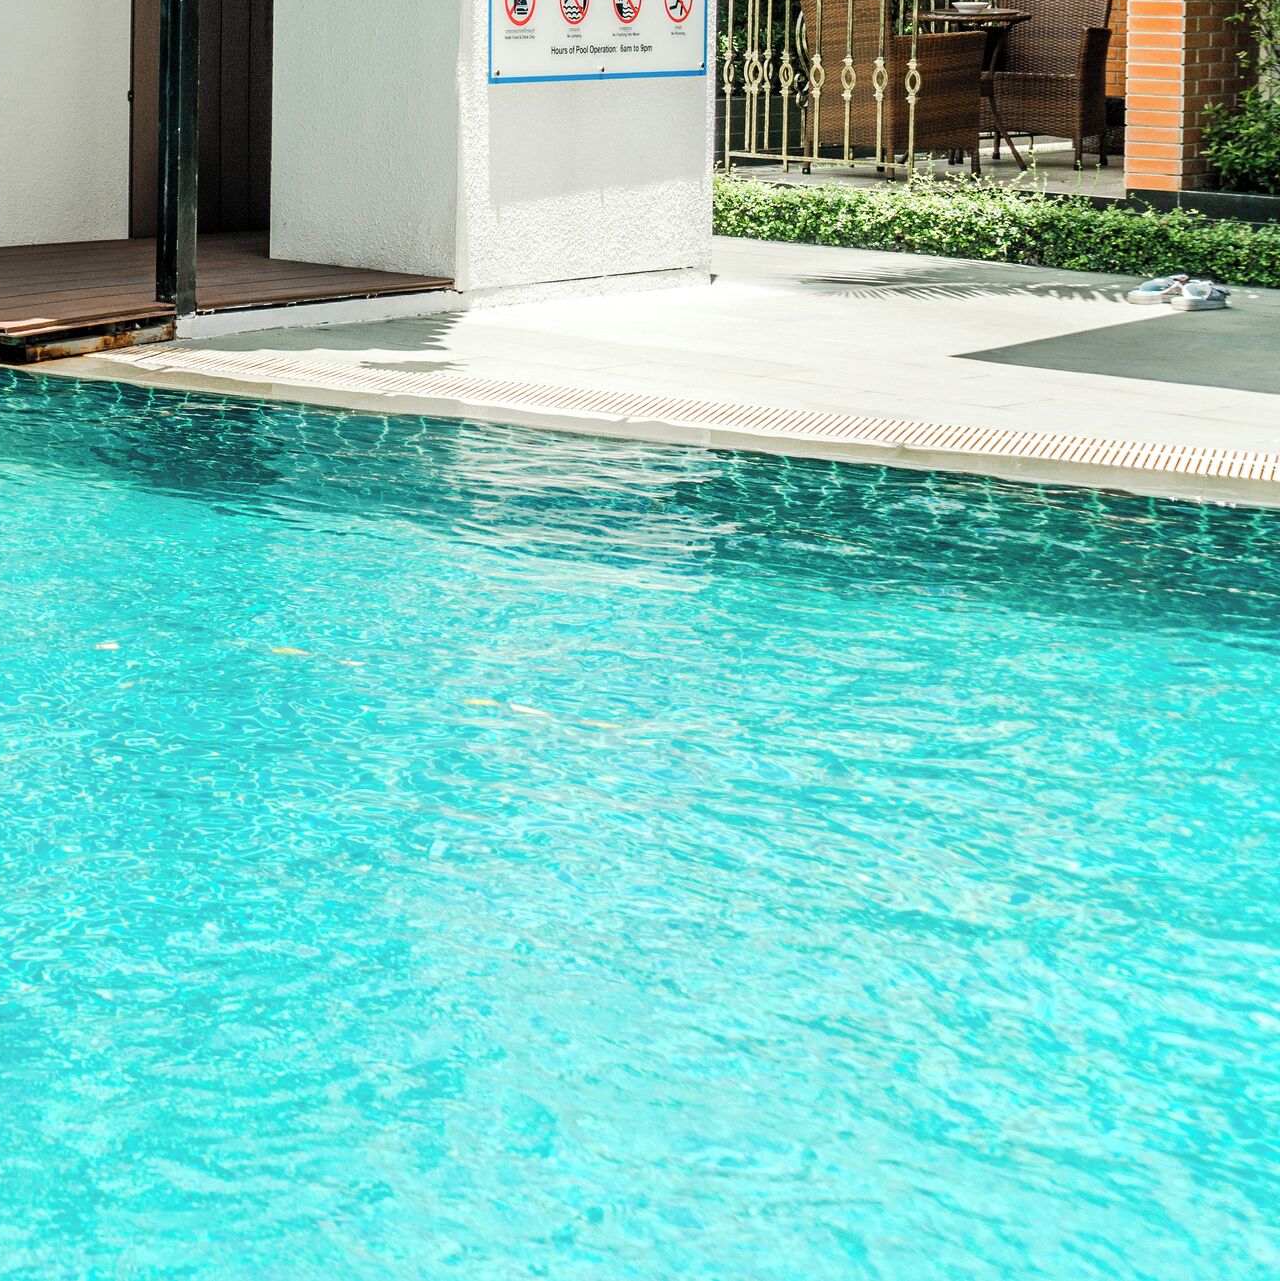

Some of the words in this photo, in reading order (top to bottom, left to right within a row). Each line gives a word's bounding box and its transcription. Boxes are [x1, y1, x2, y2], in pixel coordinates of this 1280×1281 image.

[551, 46, 568, 55] Hours
[569, 45, 575, 54] of
[576, 45, 588, 54] Pool
[589, 45, 617, 55] Operation:
[620, 44, 632, 53] 6am
[633, 44, 639, 52] to
[640, 43, 653, 54] 9pm
